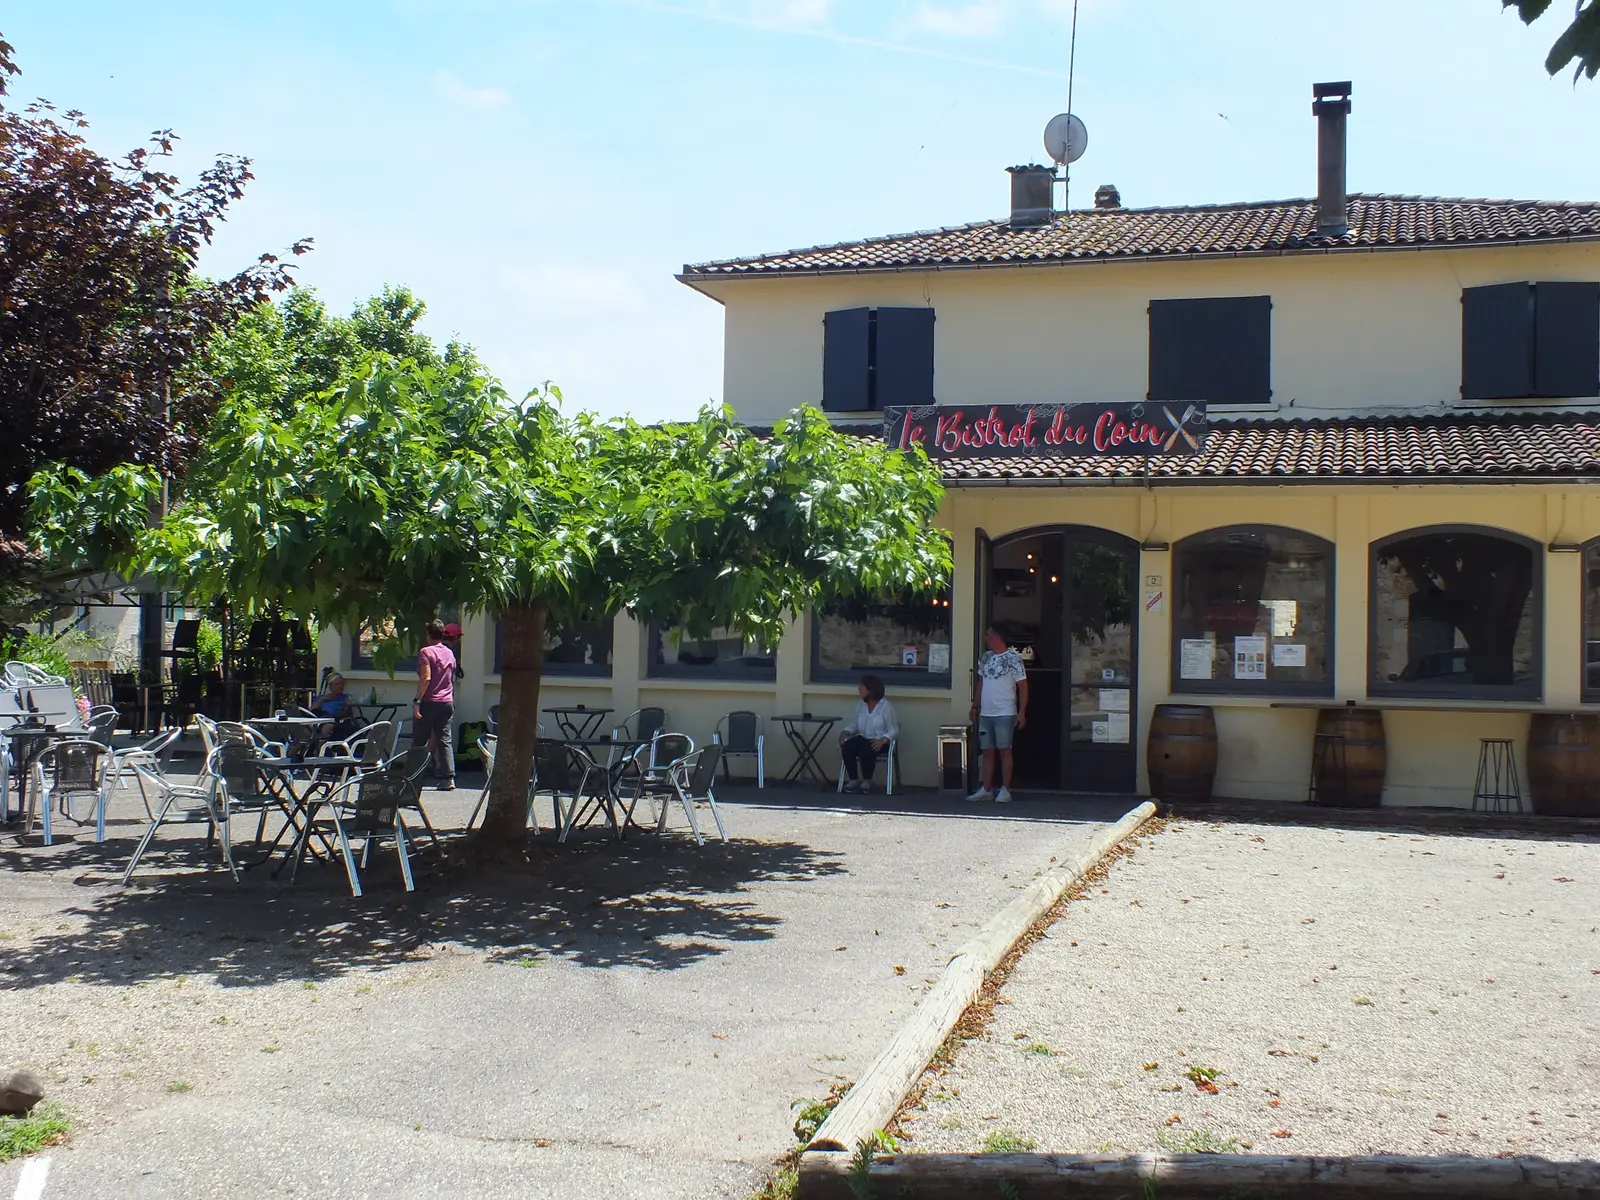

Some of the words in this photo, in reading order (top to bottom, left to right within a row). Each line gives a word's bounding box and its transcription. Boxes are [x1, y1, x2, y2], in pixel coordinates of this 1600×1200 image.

[898, 409, 928, 452] Le
[935, 407, 1038, 452] Bistrot
[1045, 408, 1089, 445] du
[1094, 409, 1169, 452] Coin
